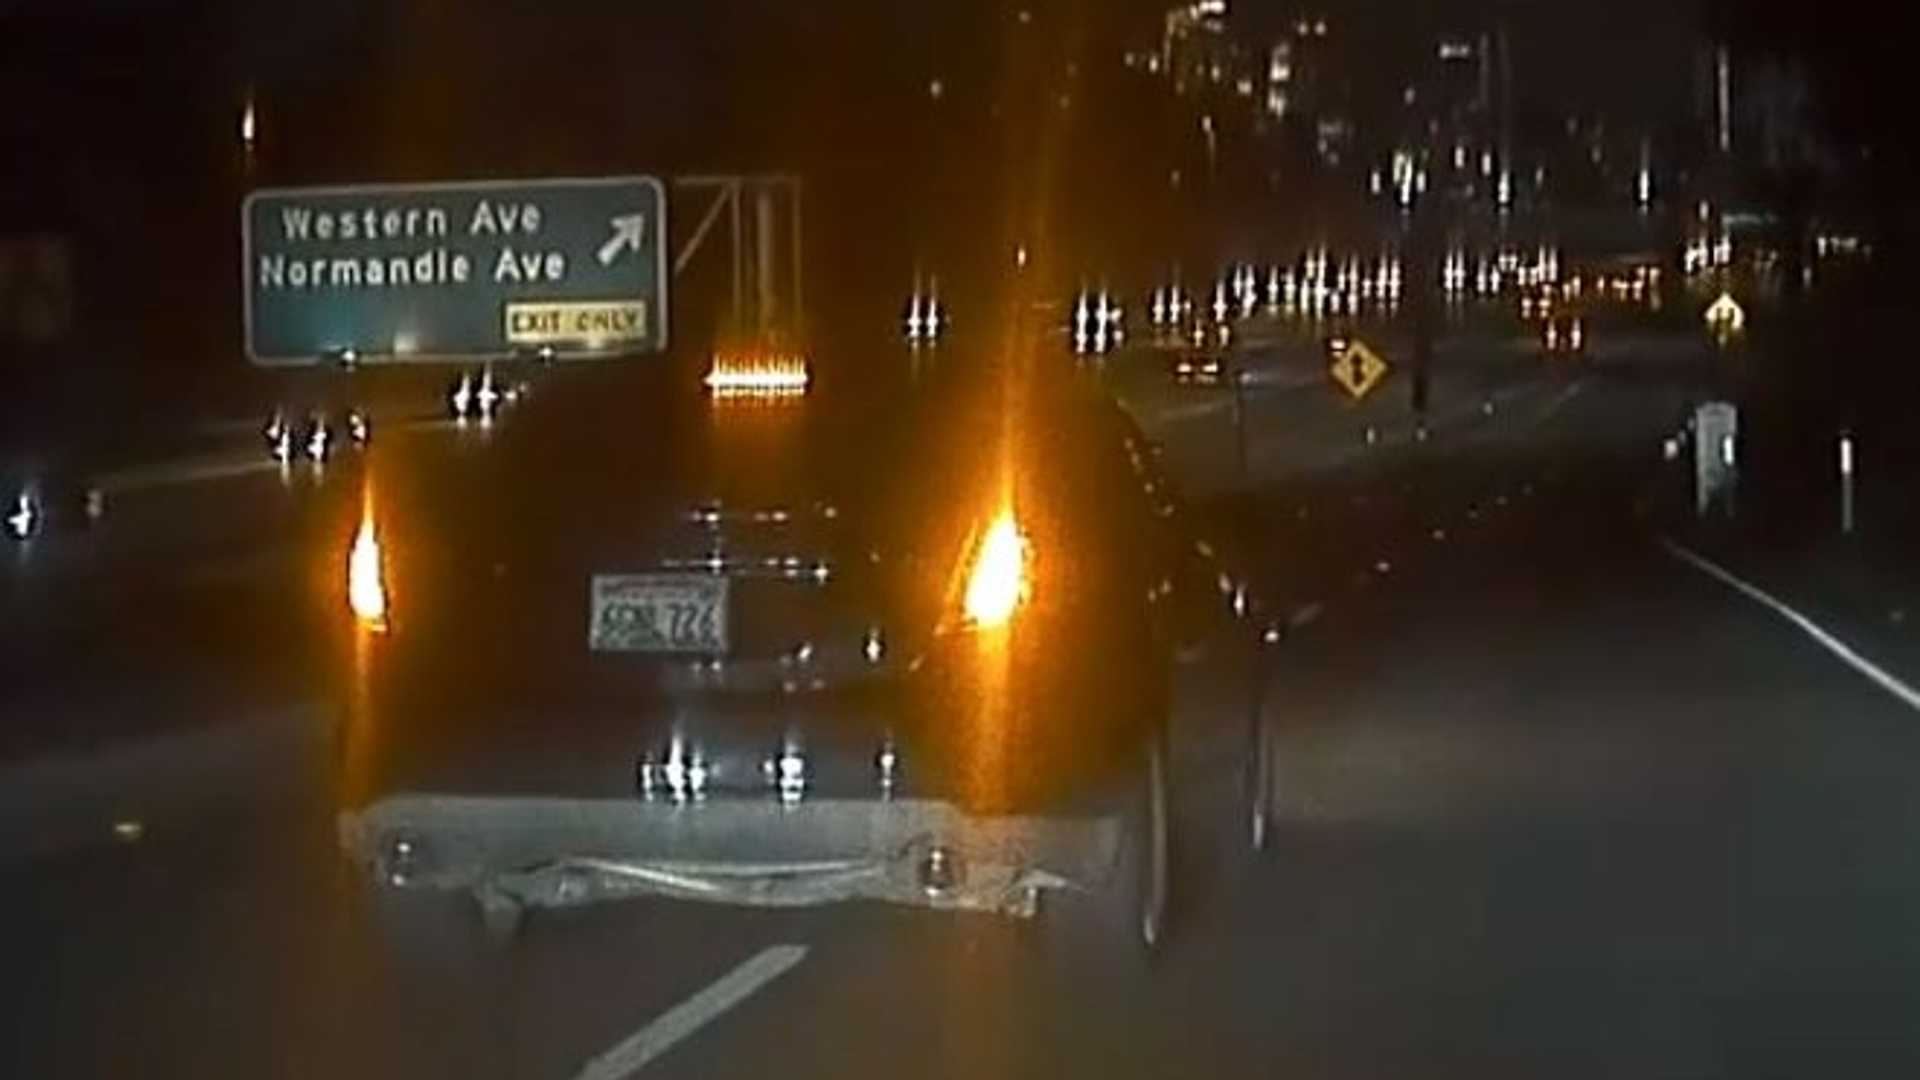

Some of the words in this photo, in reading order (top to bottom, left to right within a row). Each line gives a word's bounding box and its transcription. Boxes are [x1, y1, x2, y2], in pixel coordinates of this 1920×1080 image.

[282, 206, 447, 240] Western
[470, 200, 541, 236] Ave
[494, 247, 566, 283] Ave
[511, 309, 560, 334] EXIT
[576, 308, 638, 333] ONLY
